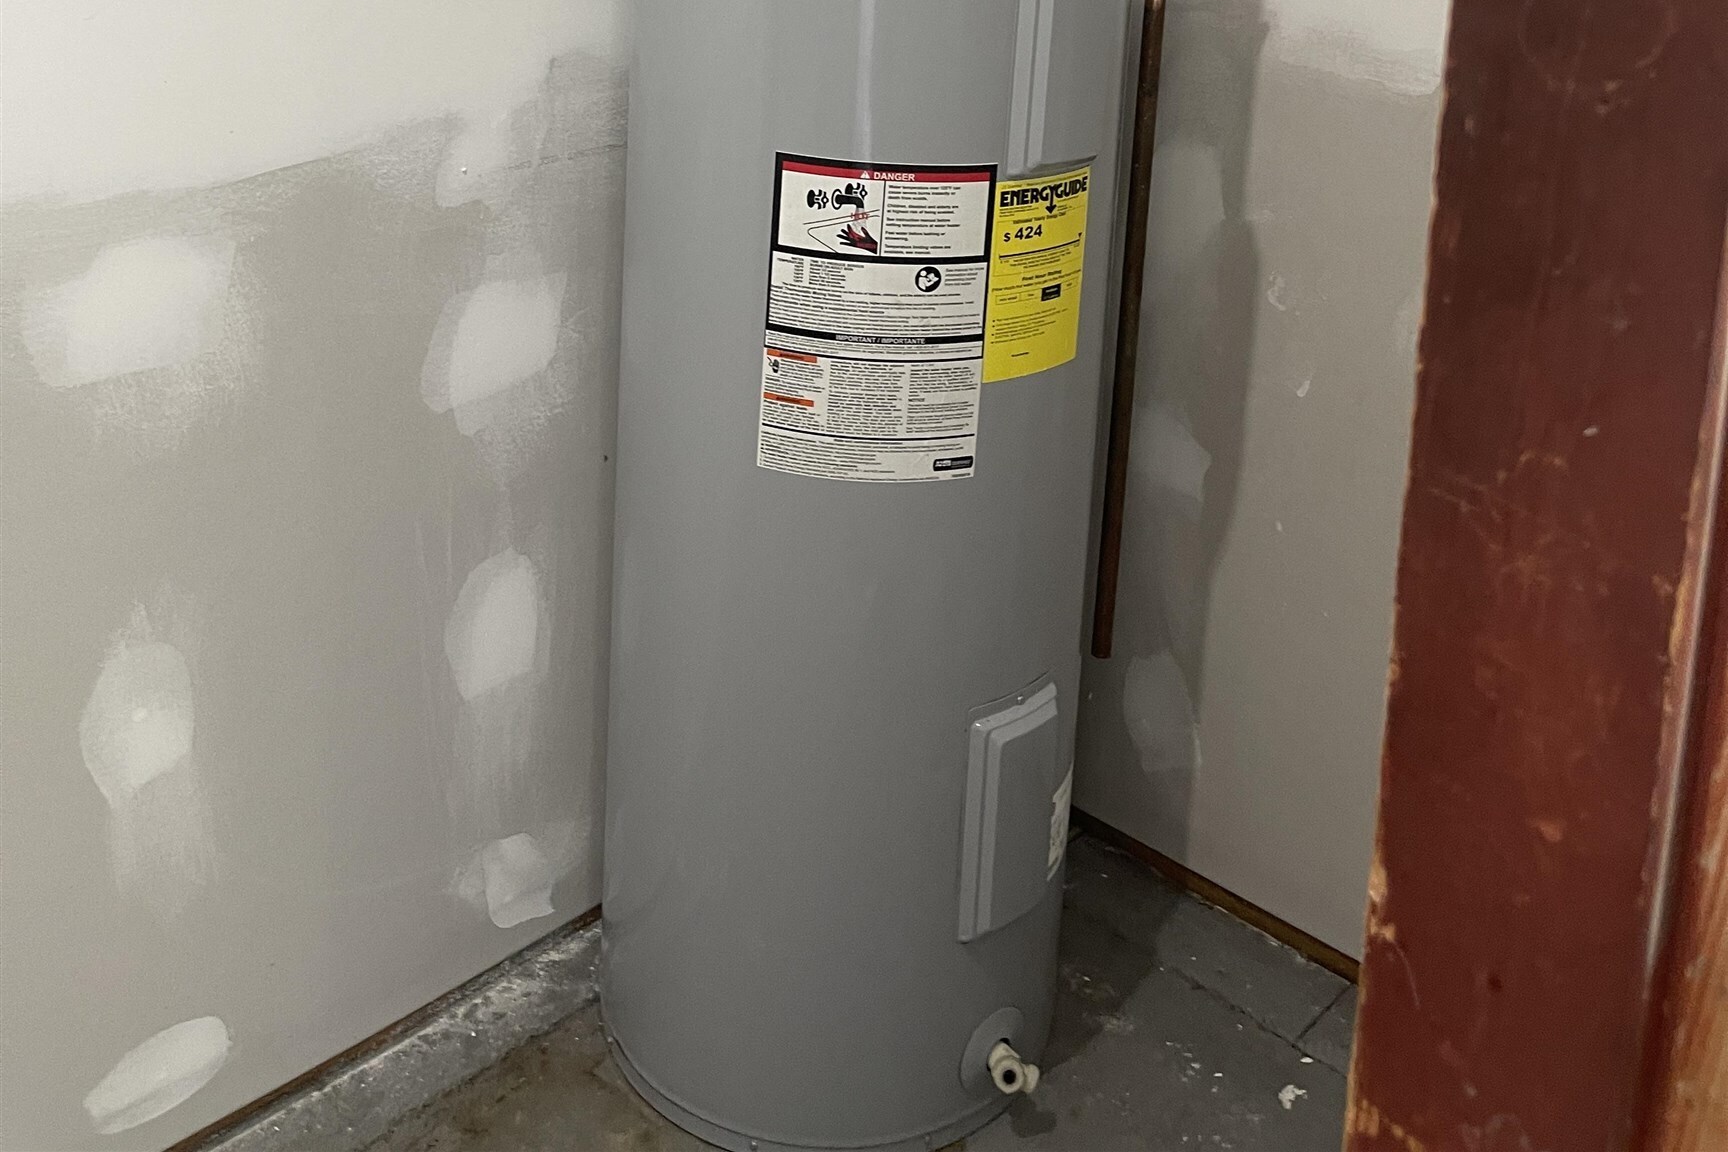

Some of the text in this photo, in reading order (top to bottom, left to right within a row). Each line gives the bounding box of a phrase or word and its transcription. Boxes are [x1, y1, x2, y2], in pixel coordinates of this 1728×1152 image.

[873, 171, 916, 181] DANGER
[1014, 224, 1043, 240] 424
[835, 334, 876, 343] IMPORTANT
